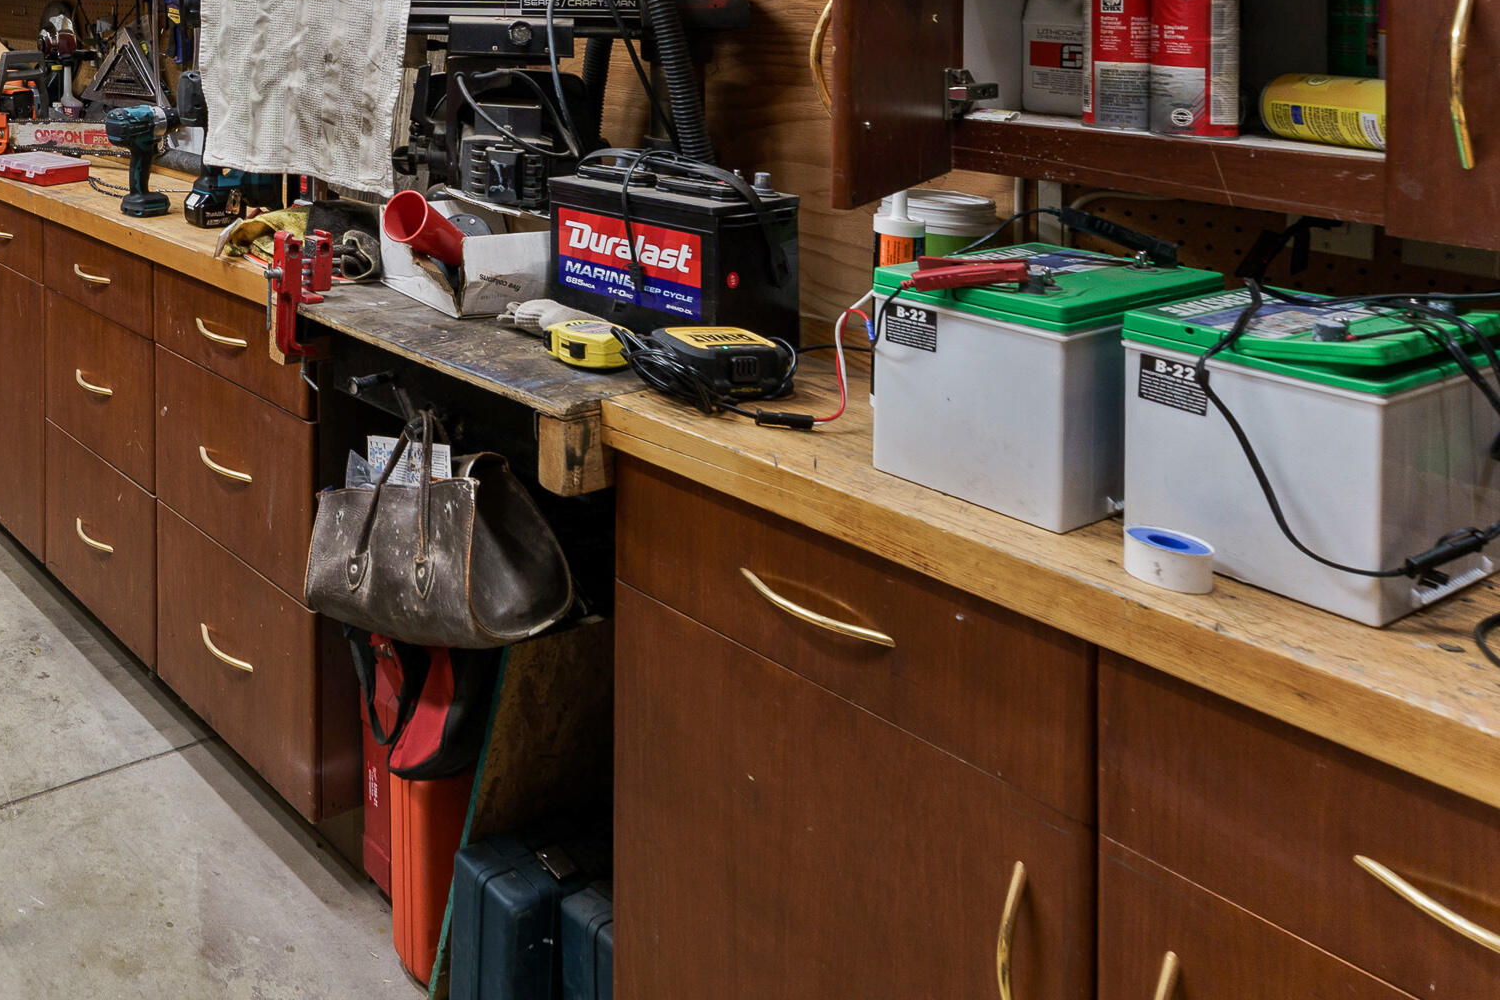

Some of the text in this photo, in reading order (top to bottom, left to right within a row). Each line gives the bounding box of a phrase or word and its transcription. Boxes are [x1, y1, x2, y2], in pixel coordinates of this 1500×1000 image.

[34, 129, 82, 144] OREGON
[564, 219, 693, 273] Duralast
[565, 260, 636, 290] MARINE
[663, 289, 694, 303] CYCLE
[896, 306, 927, 322] B-22
[1154, 359, 1196, 381] B-22
